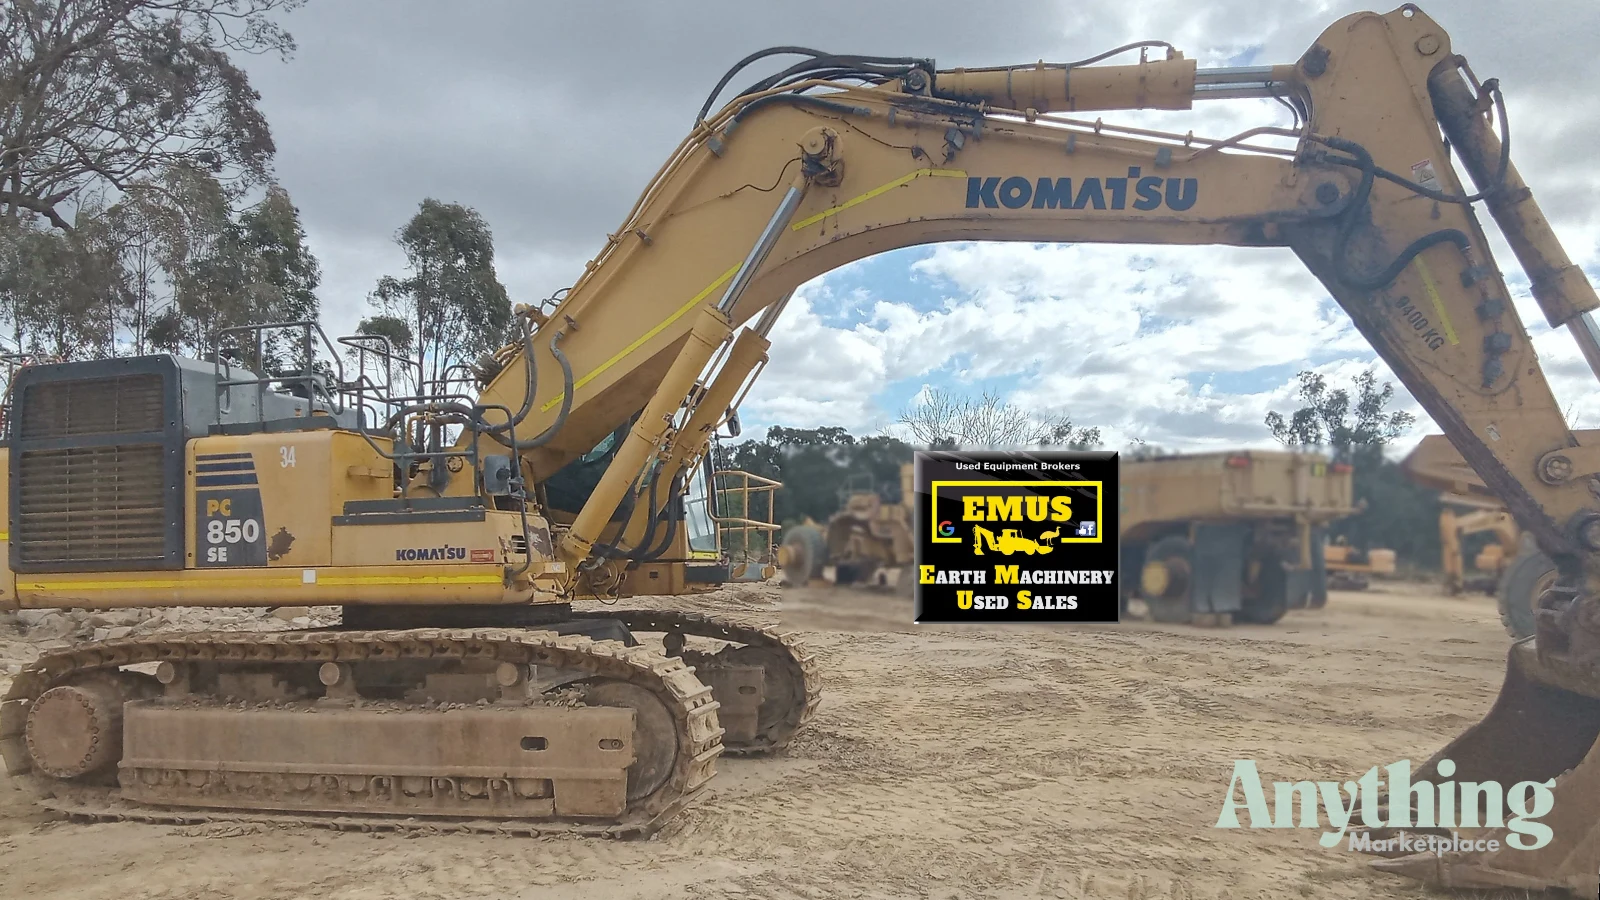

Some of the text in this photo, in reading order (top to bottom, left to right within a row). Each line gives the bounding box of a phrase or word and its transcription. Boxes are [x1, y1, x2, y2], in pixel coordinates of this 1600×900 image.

[965, 166, 1197, 211] KOMATSU
[1421, 328, 1444, 351] KG
[280, 446, 296, 468] 34
[207, 499, 231, 516] PC
[207, 519, 259, 544] 850
[207, 547, 227, 562] SE
[396, 544, 465, 561] KOMATSU
